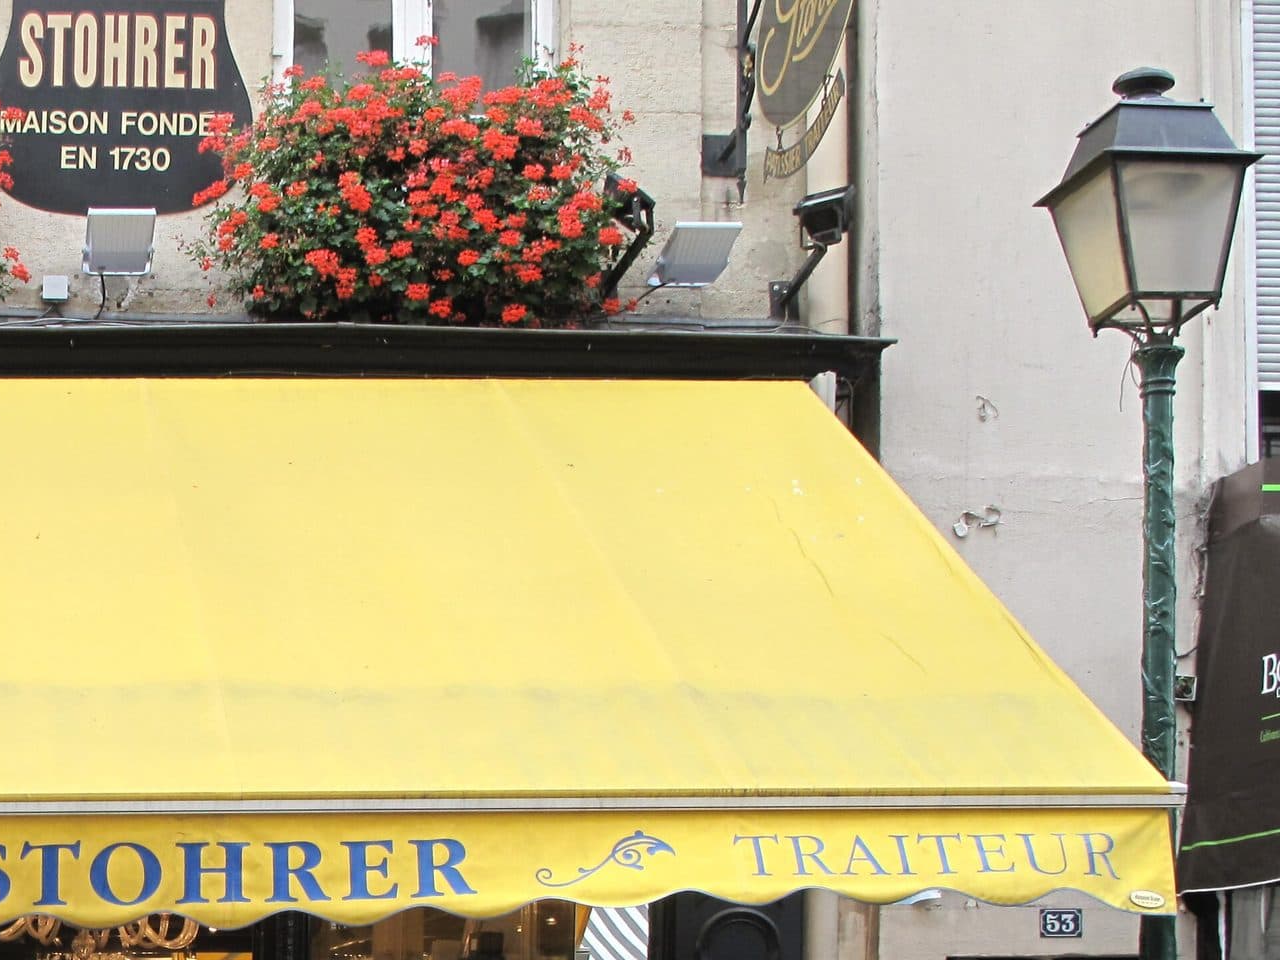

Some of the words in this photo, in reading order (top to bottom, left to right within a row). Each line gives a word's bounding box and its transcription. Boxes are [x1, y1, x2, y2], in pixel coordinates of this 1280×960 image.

[19, 12, 217, 90] STOHRER
[0, 110, 109, 134] MAISON
[60, 146, 97, 170] EN
[109, 147, 171, 172] 1730
[732, 831, 1122, 881] TRAITEUR
[1046, 913, 1075, 933] 53
